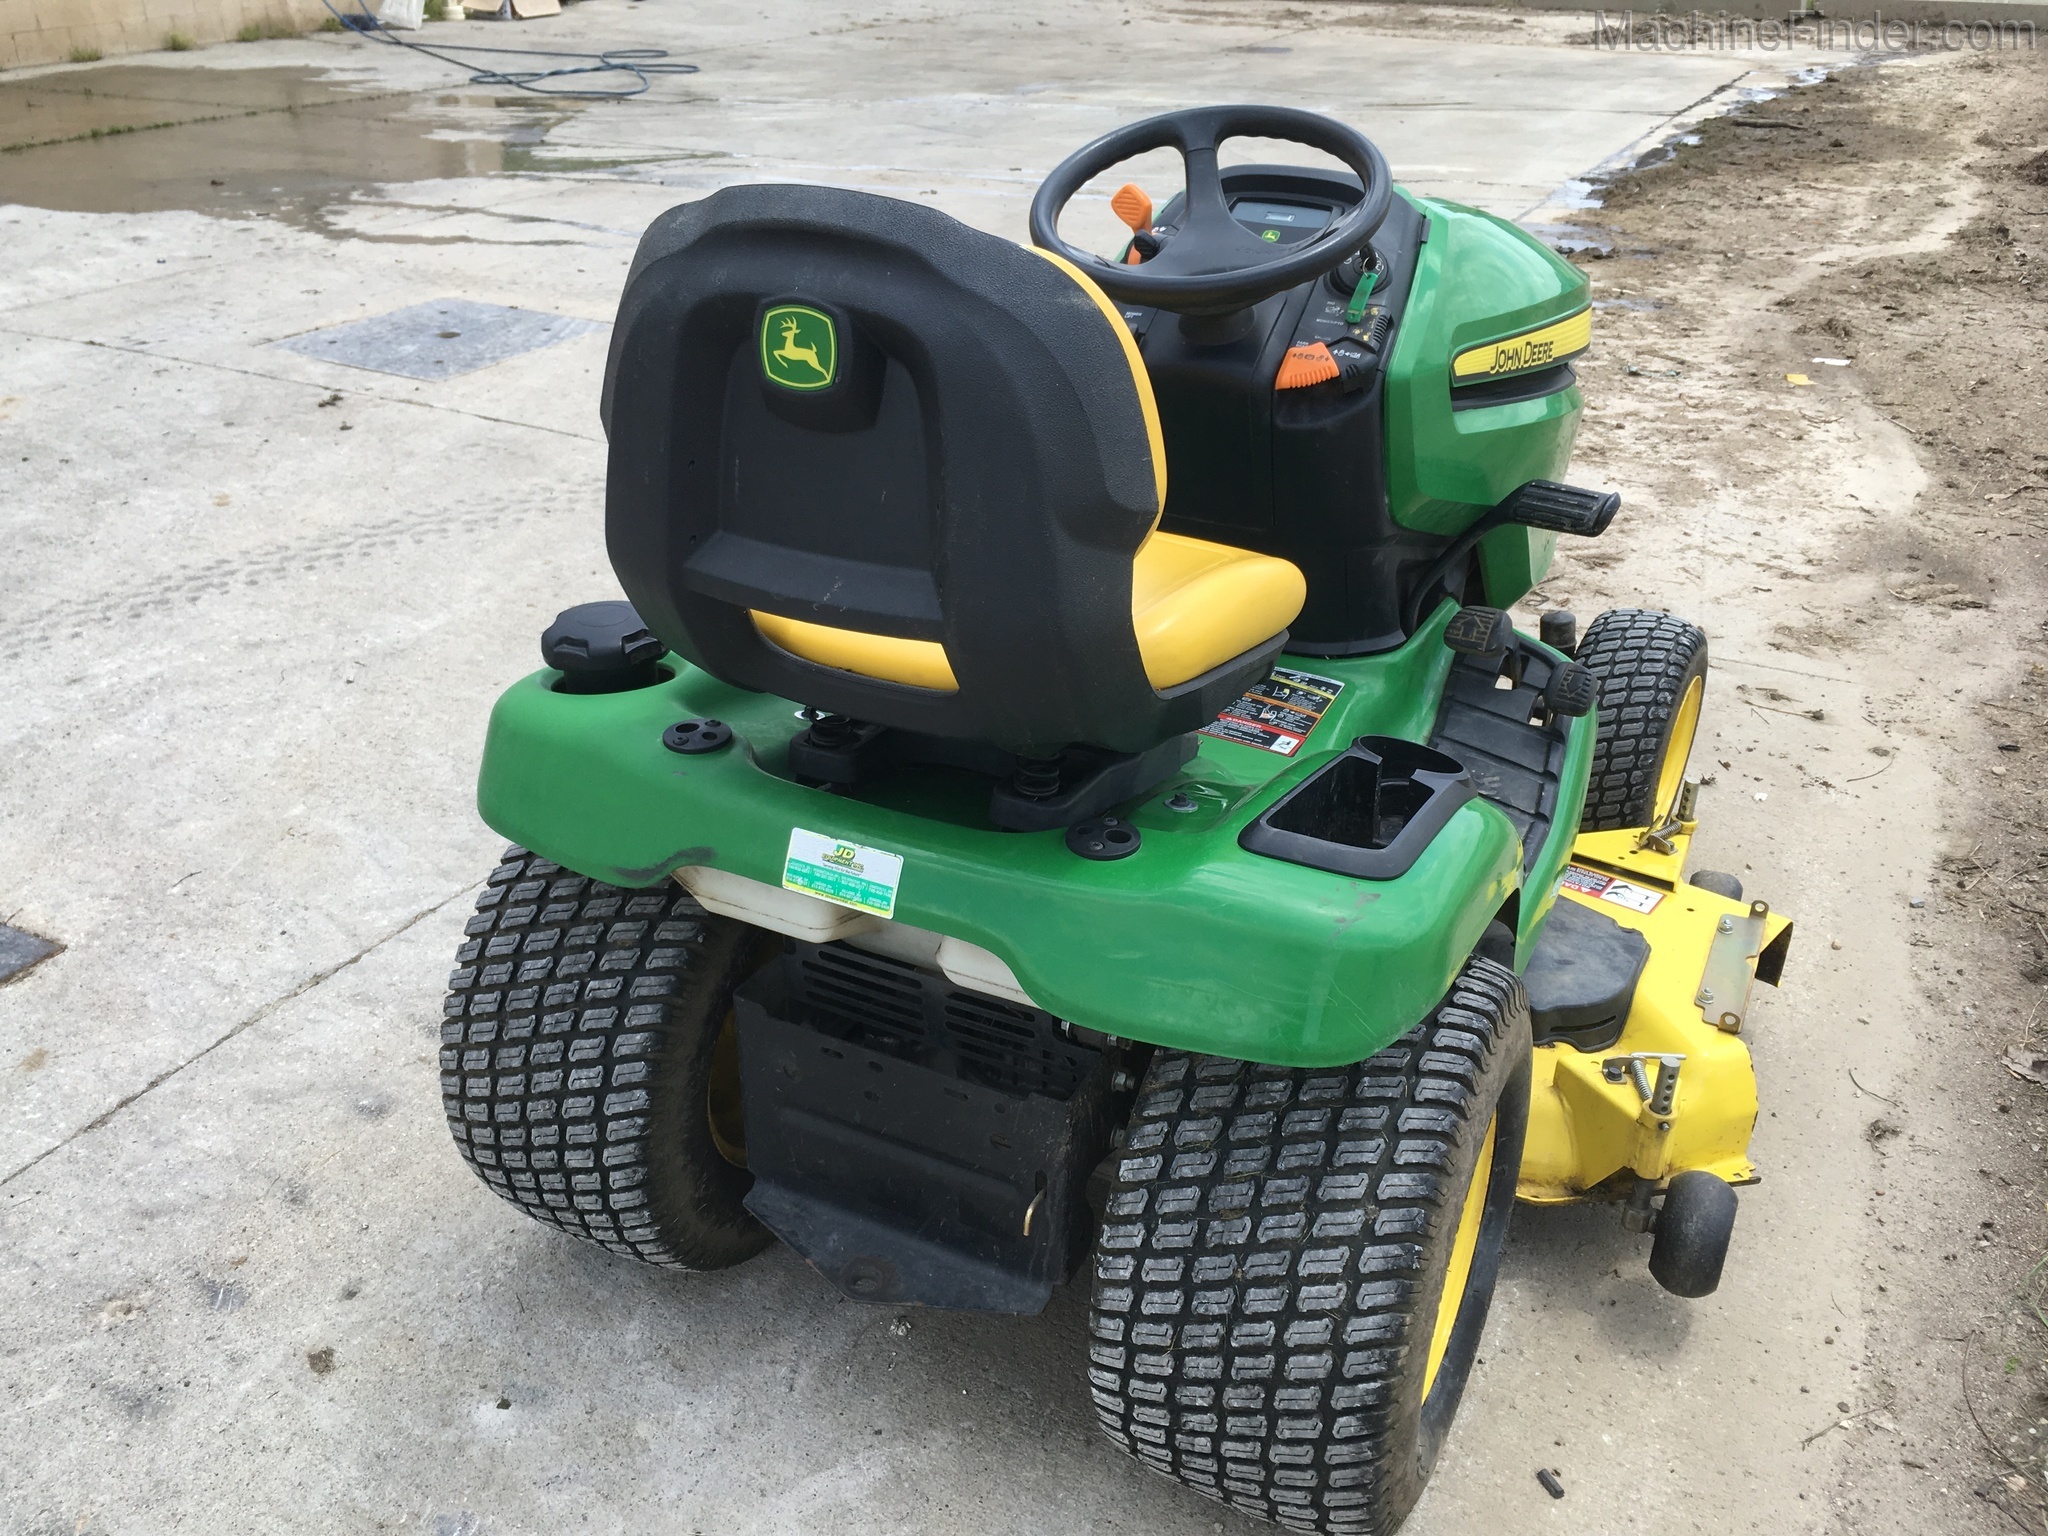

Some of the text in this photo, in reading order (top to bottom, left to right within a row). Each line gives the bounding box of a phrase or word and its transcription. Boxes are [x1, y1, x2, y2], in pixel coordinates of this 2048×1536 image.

[1490, 340, 1555, 372] JOHN DEERE
[1232, 718, 1262, 729] DANGER
[834, 847, 855, 859] JD
